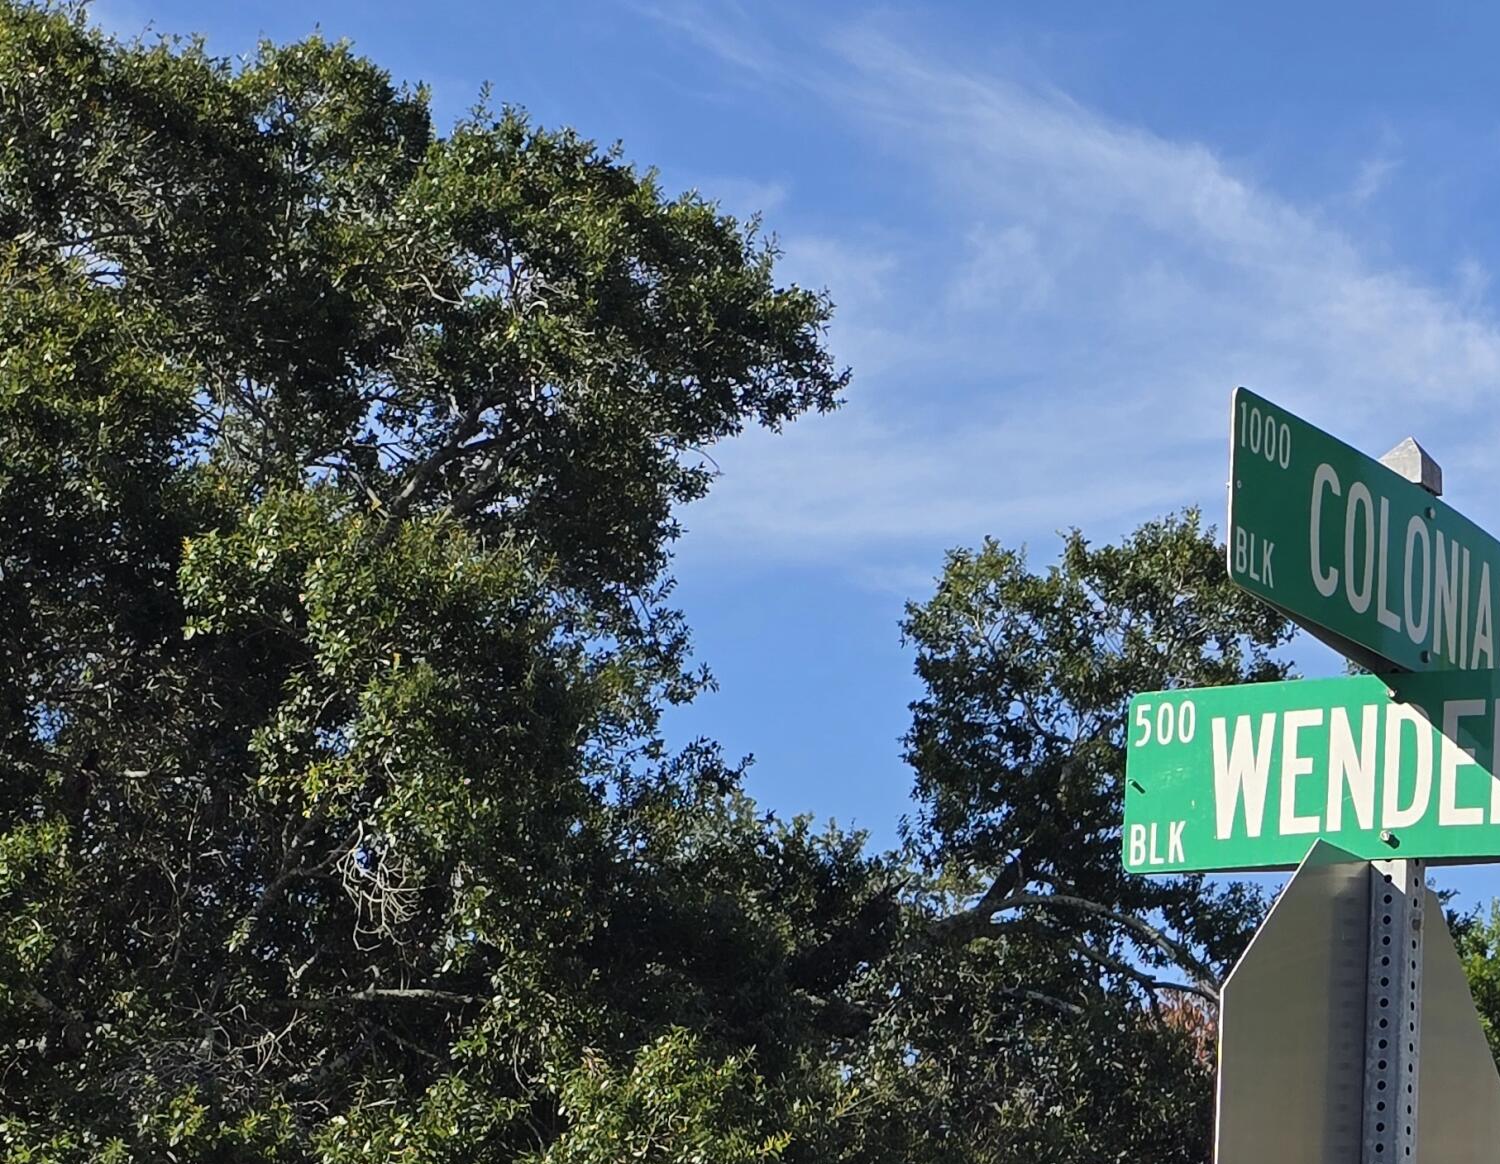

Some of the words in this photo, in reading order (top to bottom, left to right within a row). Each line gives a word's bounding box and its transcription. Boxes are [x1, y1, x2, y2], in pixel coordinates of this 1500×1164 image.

[1241, 402, 1291, 469] 1000
[1235, 526, 1275, 589] BLK
[1135, 700, 1196, 747] 500
[1129, 820, 1187, 867] BLK
